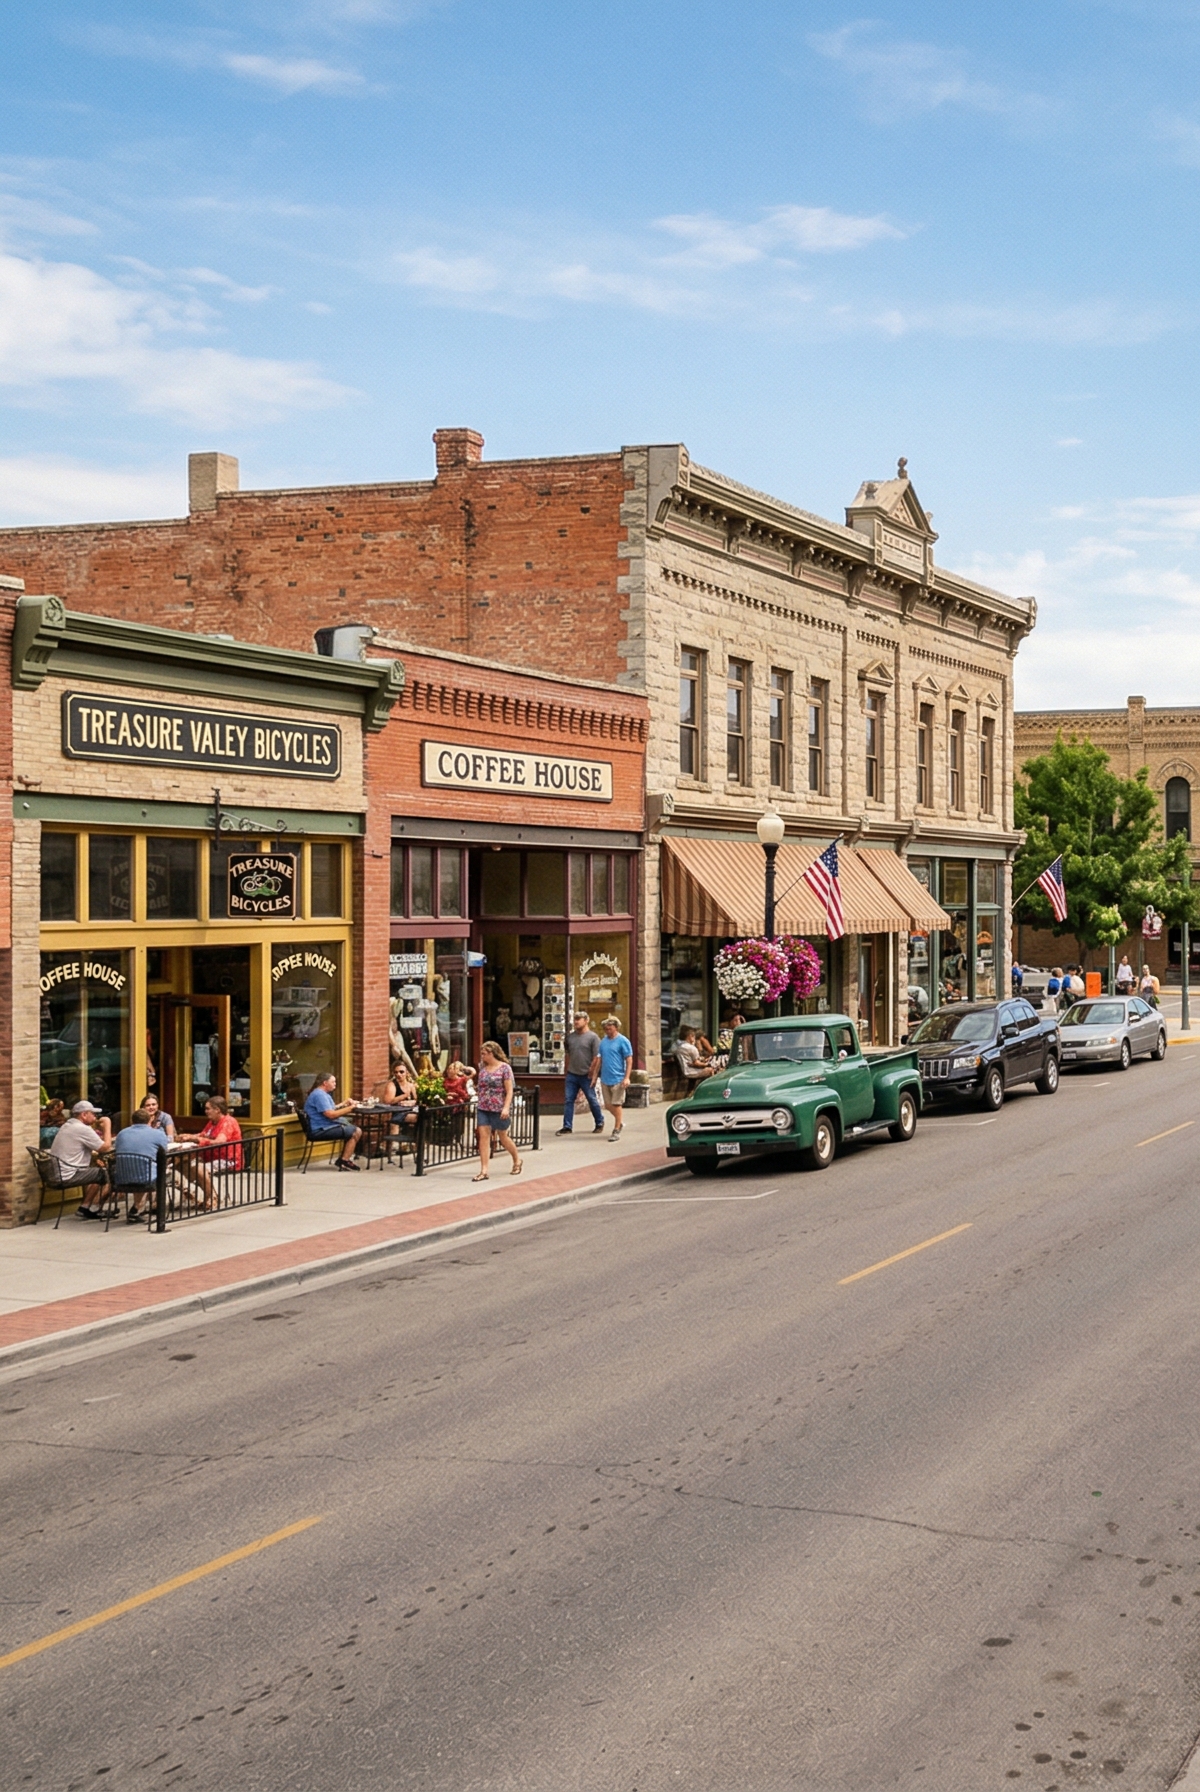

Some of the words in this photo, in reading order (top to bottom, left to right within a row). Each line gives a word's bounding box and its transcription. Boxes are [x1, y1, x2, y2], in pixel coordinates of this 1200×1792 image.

[78, 707, 183, 751] TREASURE
[190, 720, 248, 757] VALEY
[255, 728, 331, 765] BICYCLES
[438, 751, 526, 785] COFFEE
[534, 761, 602, 792] HOUSE
[231, 895, 291, 912] BICYCLES
[40, 962, 80, 996] OFFEE
[83, 962, 126, 991] HOUSE
